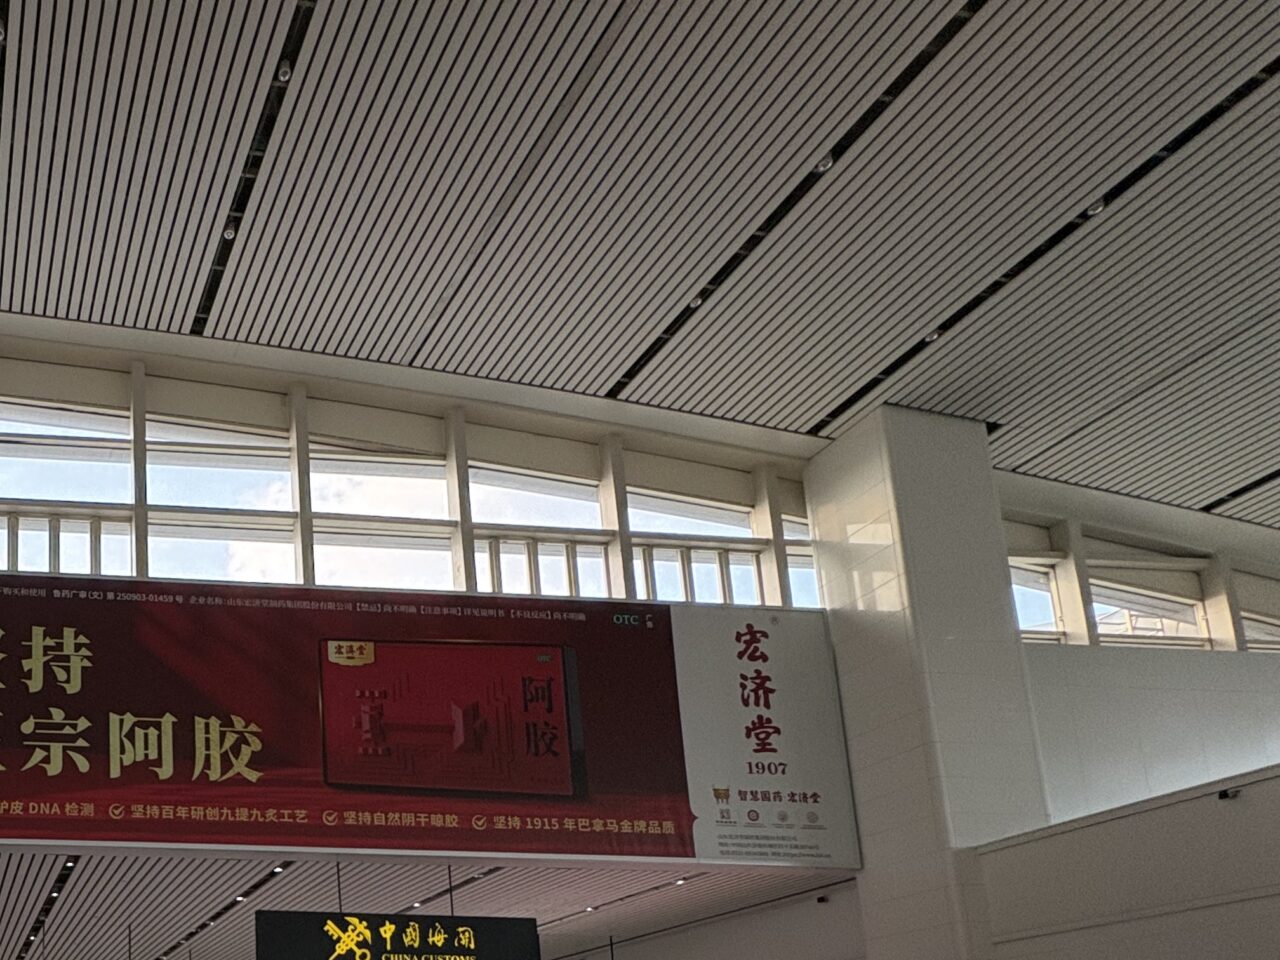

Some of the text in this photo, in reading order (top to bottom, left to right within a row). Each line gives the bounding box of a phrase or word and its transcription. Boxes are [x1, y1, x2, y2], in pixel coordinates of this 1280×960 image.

[613, 614, 639, 625] OTC
[735, 623, 781, 753] 宏济堂
[521, 675, 561, 757] 阿胶
[746, 761, 788, 776] 1907
[29, 803, 61, 816] DNA
[65, 801, 95, 817] 检测
[343, 810, 459, 829] 坚持自然阴干晾胶
[493, 815, 676, 835] 坚持 1915 年巴拿马金牌品质
